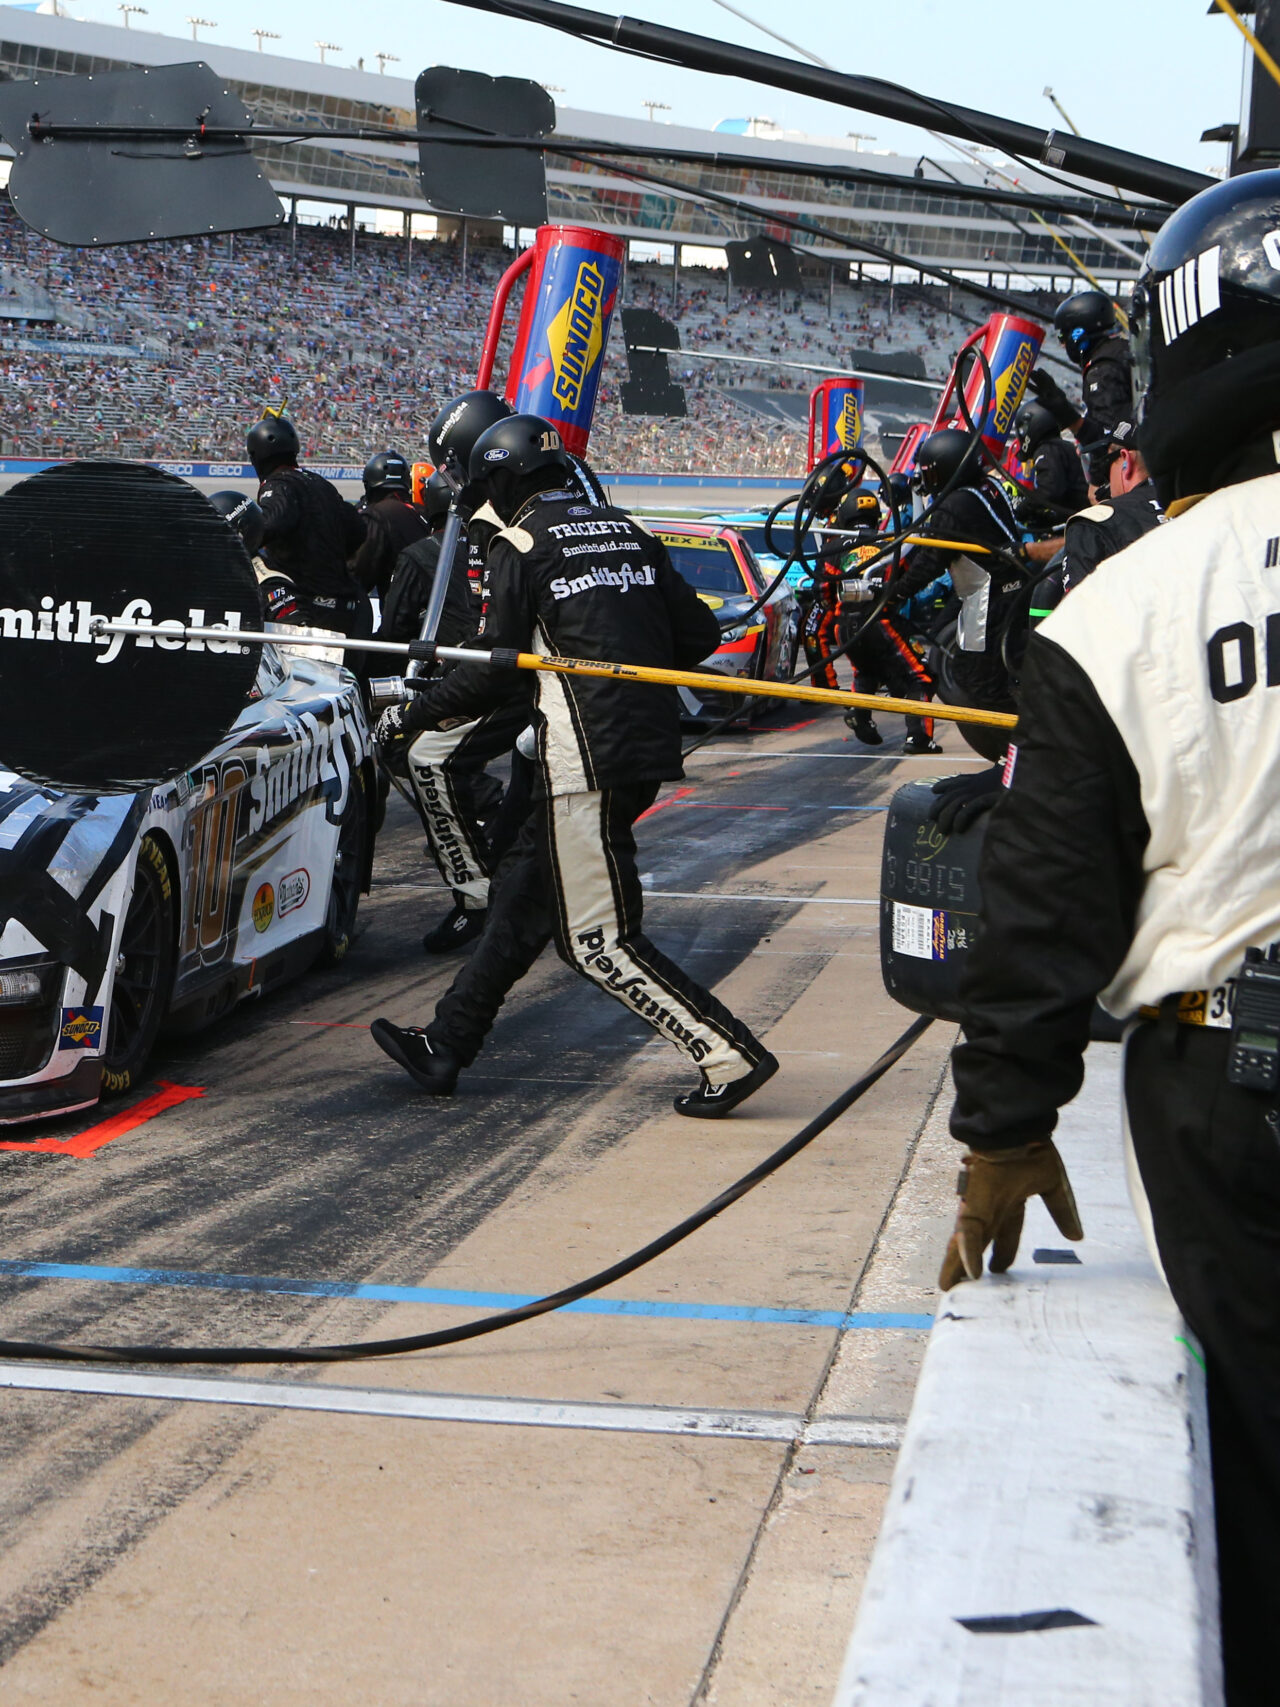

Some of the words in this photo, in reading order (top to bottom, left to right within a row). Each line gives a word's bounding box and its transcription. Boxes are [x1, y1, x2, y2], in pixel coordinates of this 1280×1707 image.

[557, 266, 605, 404] SUNOCO
[994, 344, 1032, 430] SUNOCO
[436, 402, 468, 446] Smithfield
[540, 431, 560, 450] 10
[209, 464, 242, 476] GEICO
[341, 468, 364, 478] ZONE
[548, 521, 632, 538] TRICKETT
[562, 541, 641, 557] Smithfield.com
[276, 587, 286, 595] 75
[550, 562, 656, 600] Smithfiel
[415, 764, 475, 886] Smithfield
[180, 756, 249, 968] 10
[938, 912, 946, 960] GOODYEAR
[578, 926, 712, 1063] Smithfield
[63, 1022, 96, 1035] SUNOCO
